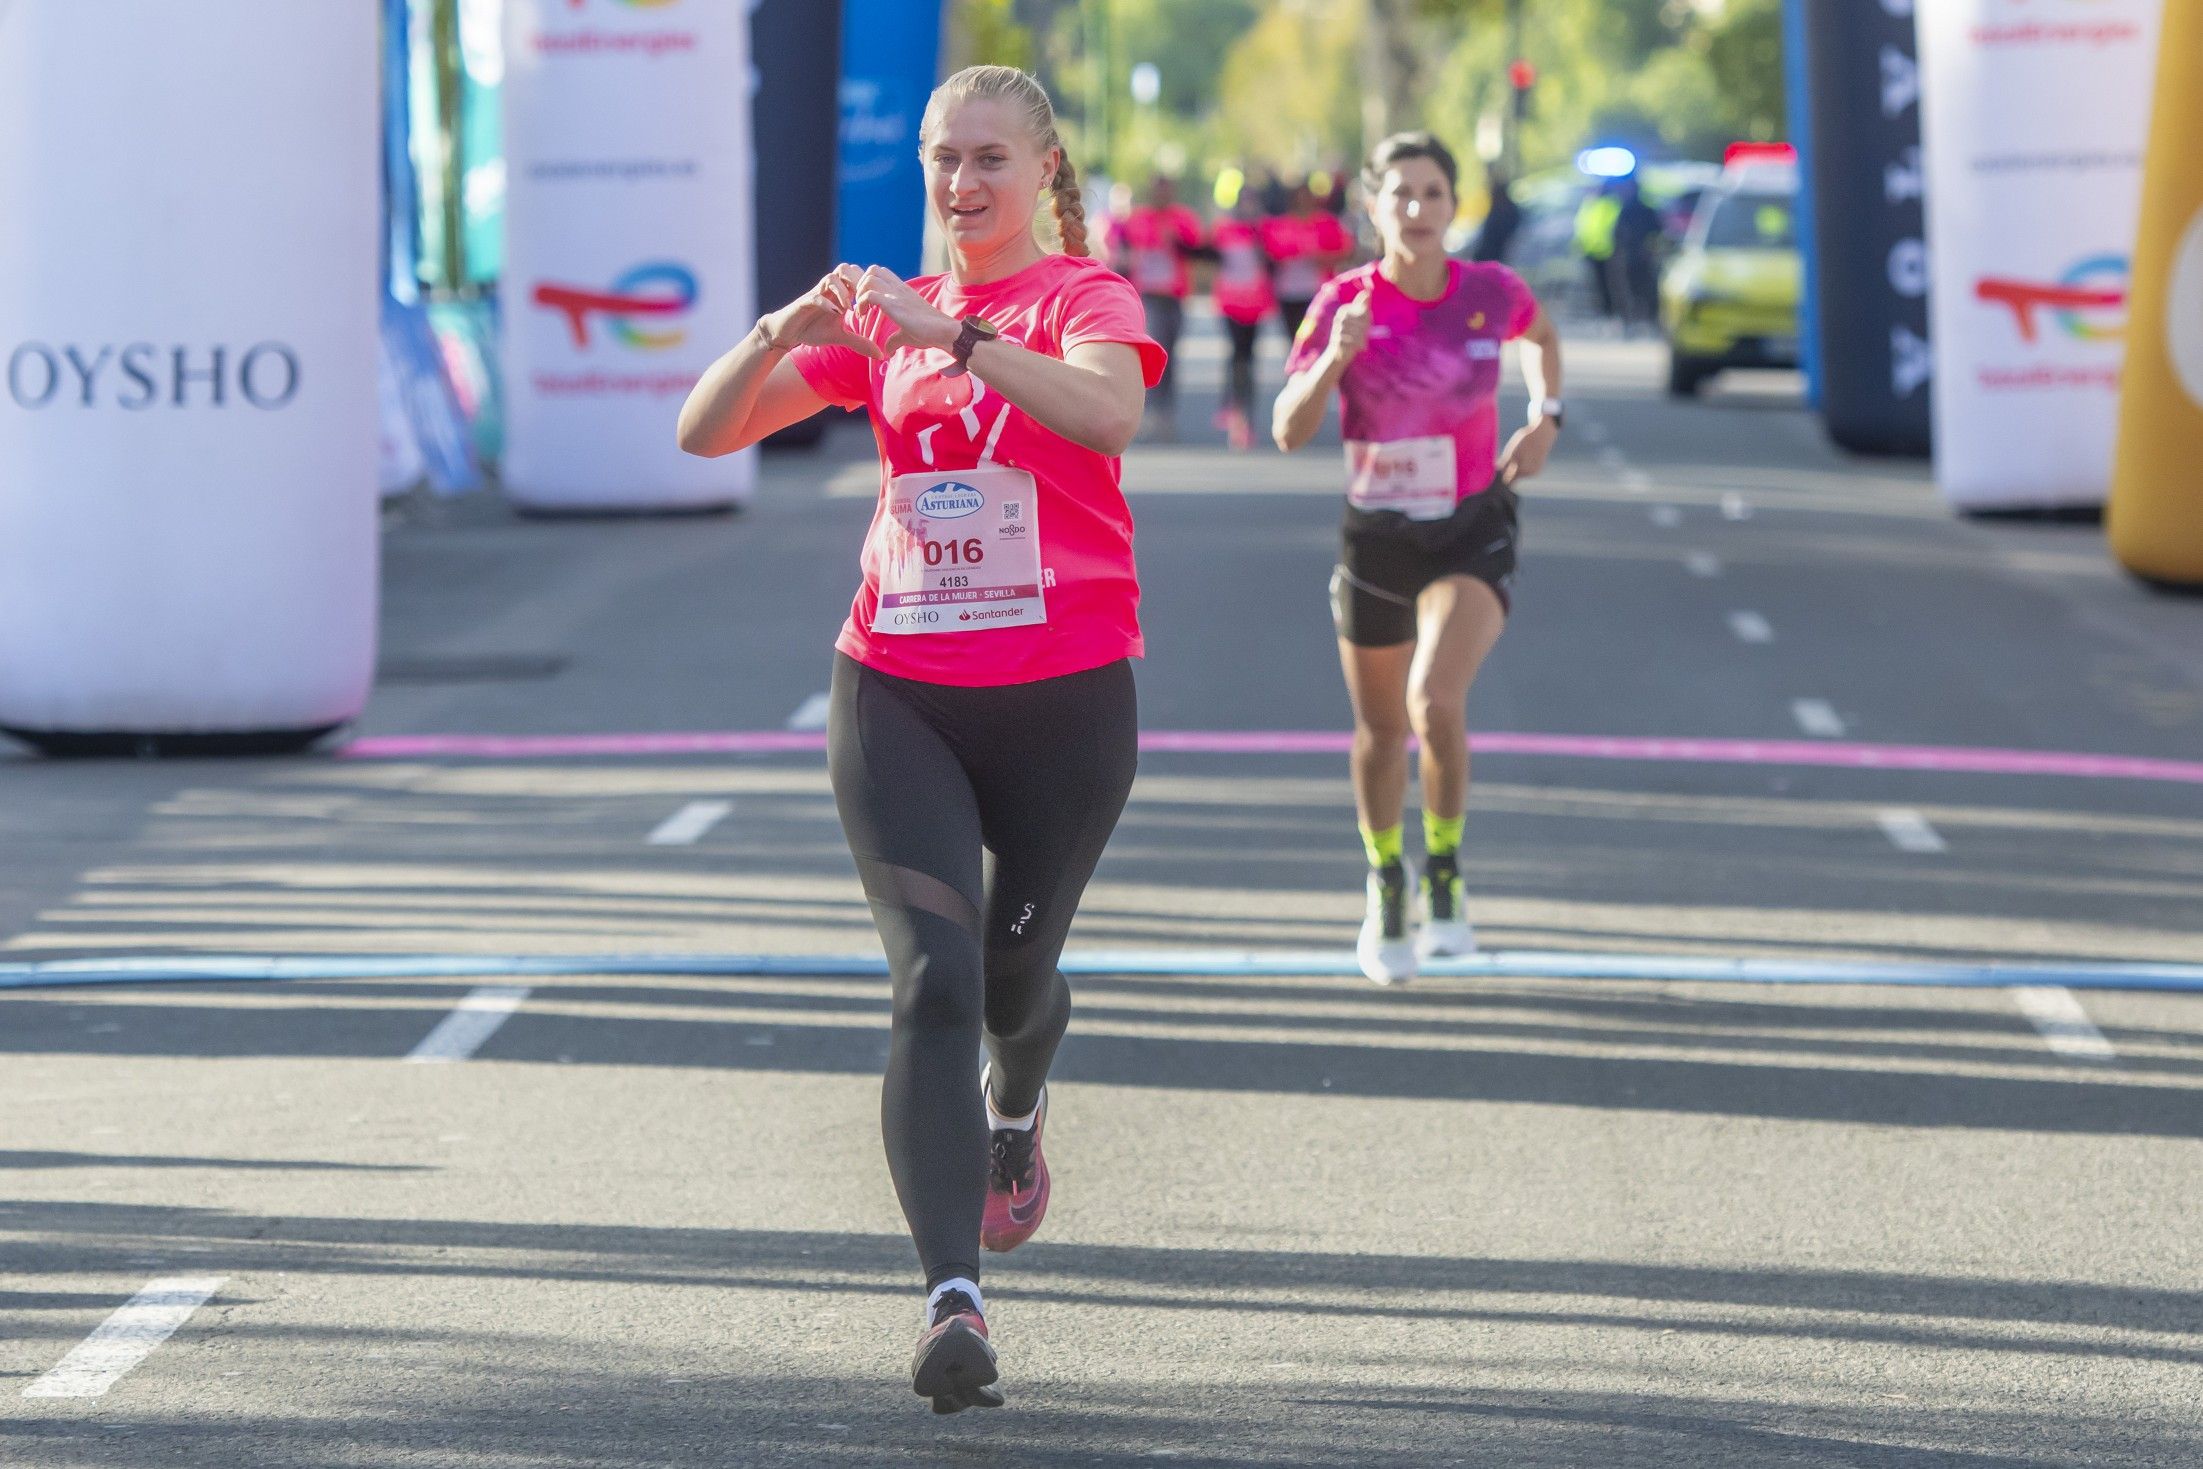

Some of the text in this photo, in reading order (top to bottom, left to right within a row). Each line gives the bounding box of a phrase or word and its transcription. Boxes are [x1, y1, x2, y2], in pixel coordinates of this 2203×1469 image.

[8, 340, 302, 411] OYSHO
[921, 497, 979, 511] ASTURIANA
[923, 538, 984, 566] 016
[940, 576, 969, 588] 4183
[899, 589, 1016, 604] CARRERA DE LA MUJER SEVILLA
[895, 607, 1024, 625] OYSHO Santander
